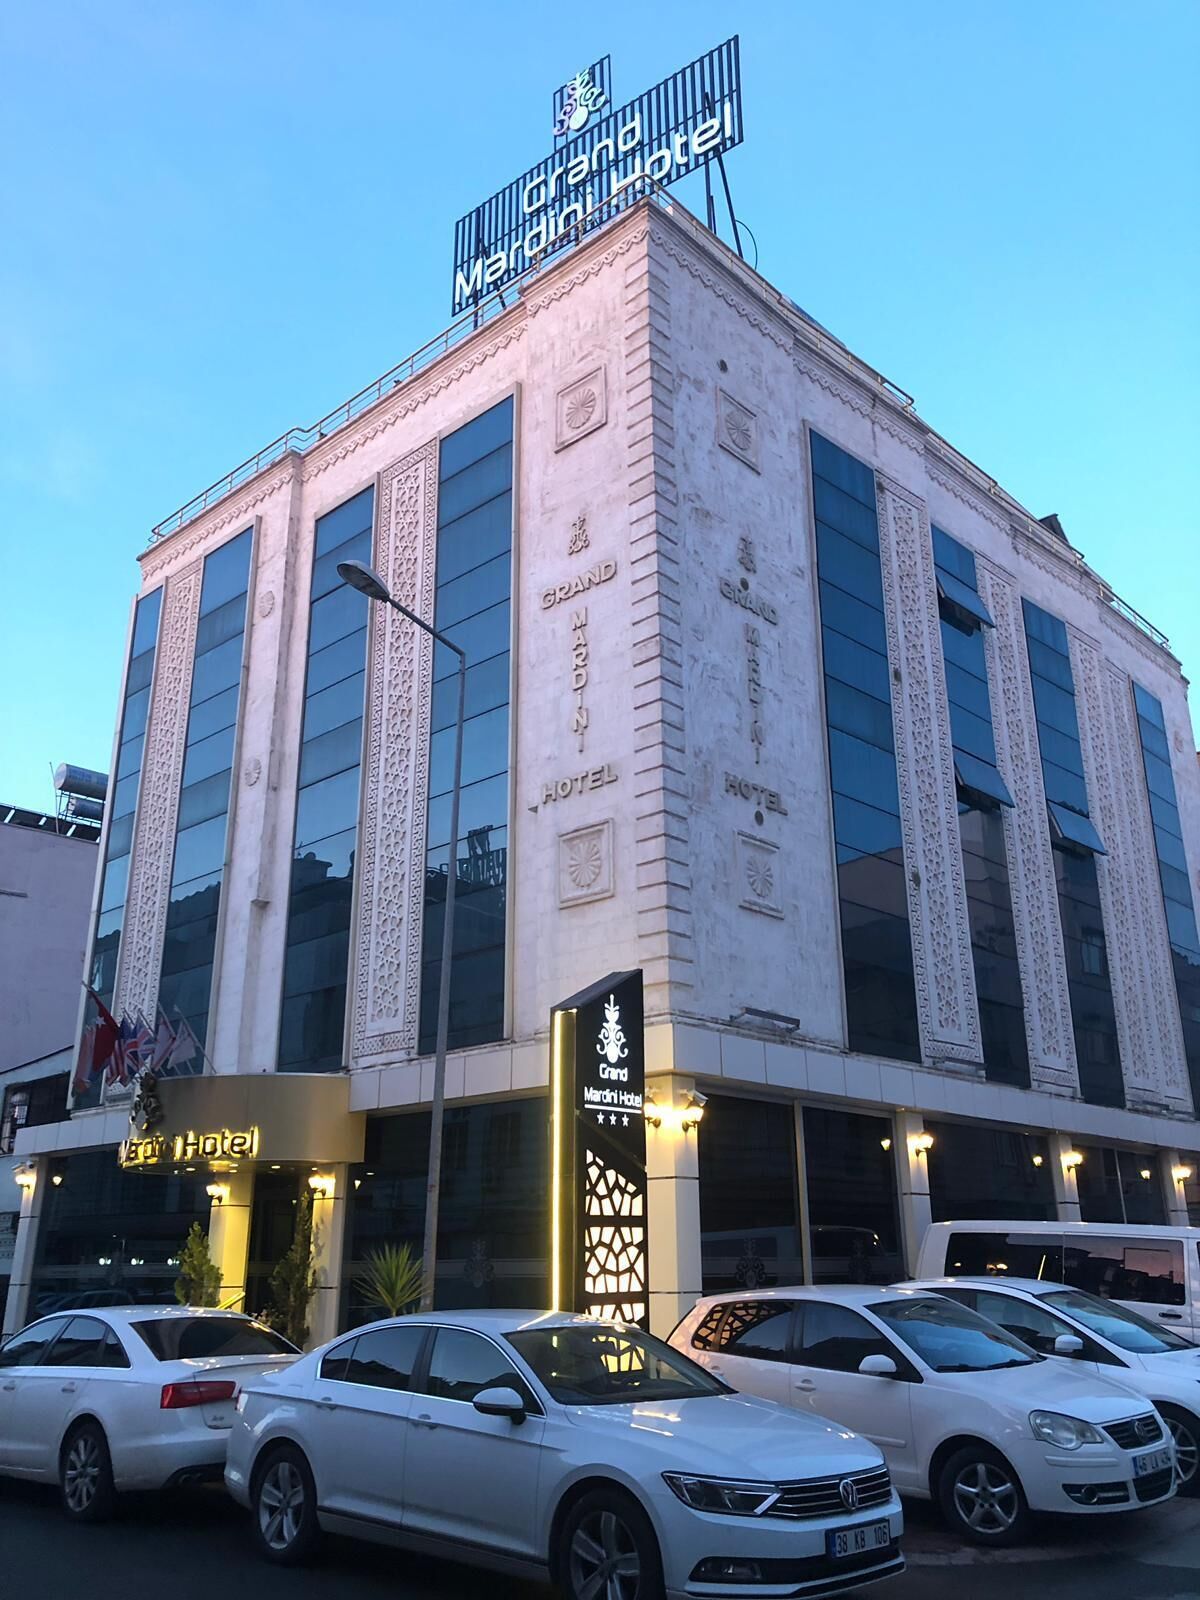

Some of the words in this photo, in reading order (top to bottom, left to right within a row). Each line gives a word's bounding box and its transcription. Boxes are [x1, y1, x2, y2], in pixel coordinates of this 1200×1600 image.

[523, 112, 641, 215] Grand
[454, 186, 594, 305] Mardini
[611, 102, 732, 208] Hotel
[540, 560, 618, 610] GRAND
[719, 576, 779, 626] GRAND
[571, 606, 589, 753] MARDINI
[541, 763, 618, 805] HOTEL
[724, 771, 789, 817] HOTEL
[599, 1063, 629, 1082] Grand
[584, 1086, 618, 1105] Mardini
[619, 1090, 642, 1107] Hotel
[185, 1124, 259, 1160] Hotel
[836, 1533, 848, 1555] 38
